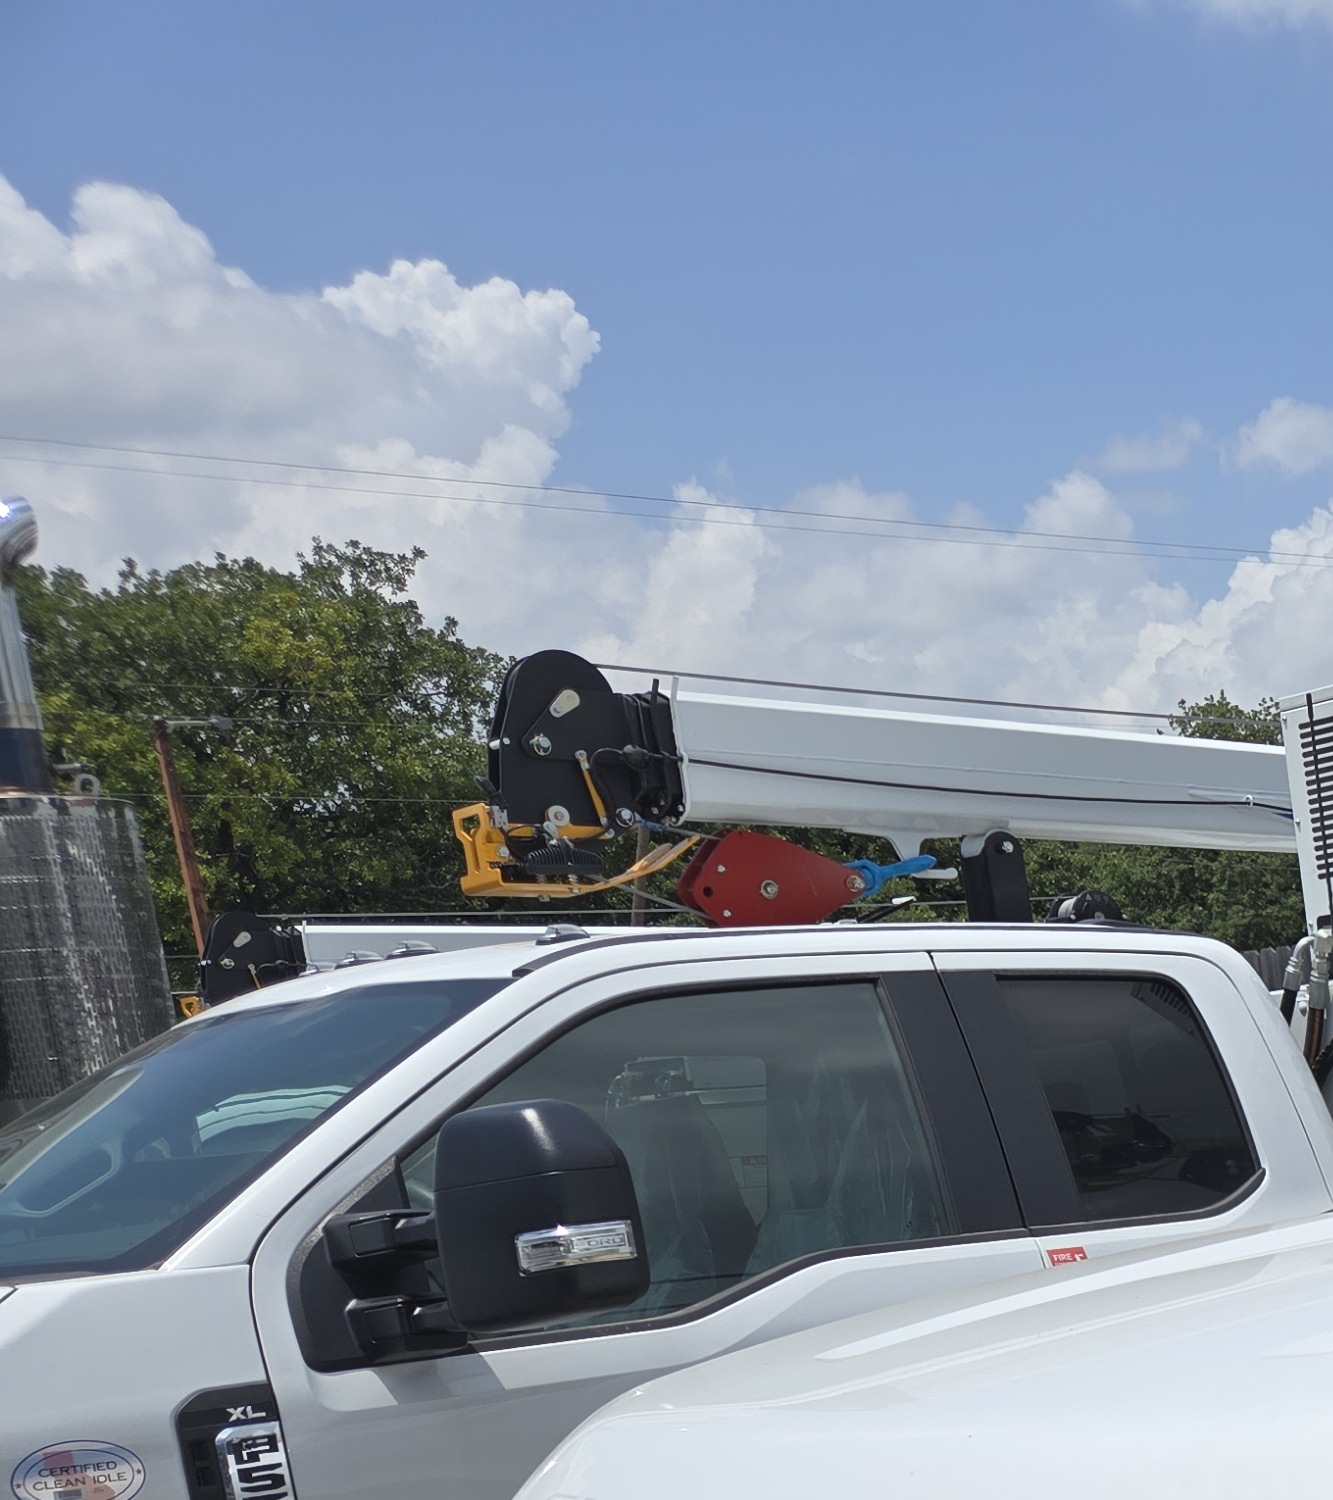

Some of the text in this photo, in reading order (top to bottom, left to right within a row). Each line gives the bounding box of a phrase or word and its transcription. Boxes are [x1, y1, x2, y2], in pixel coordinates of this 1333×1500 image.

[1053, 1253, 1073, 1261] FIRE
[226, 1405, 267, 1422] XL
[38, 1460, 118, 1478] CERTIFIED
[32, 1471, 127, 1491] CLEAN IDLE
